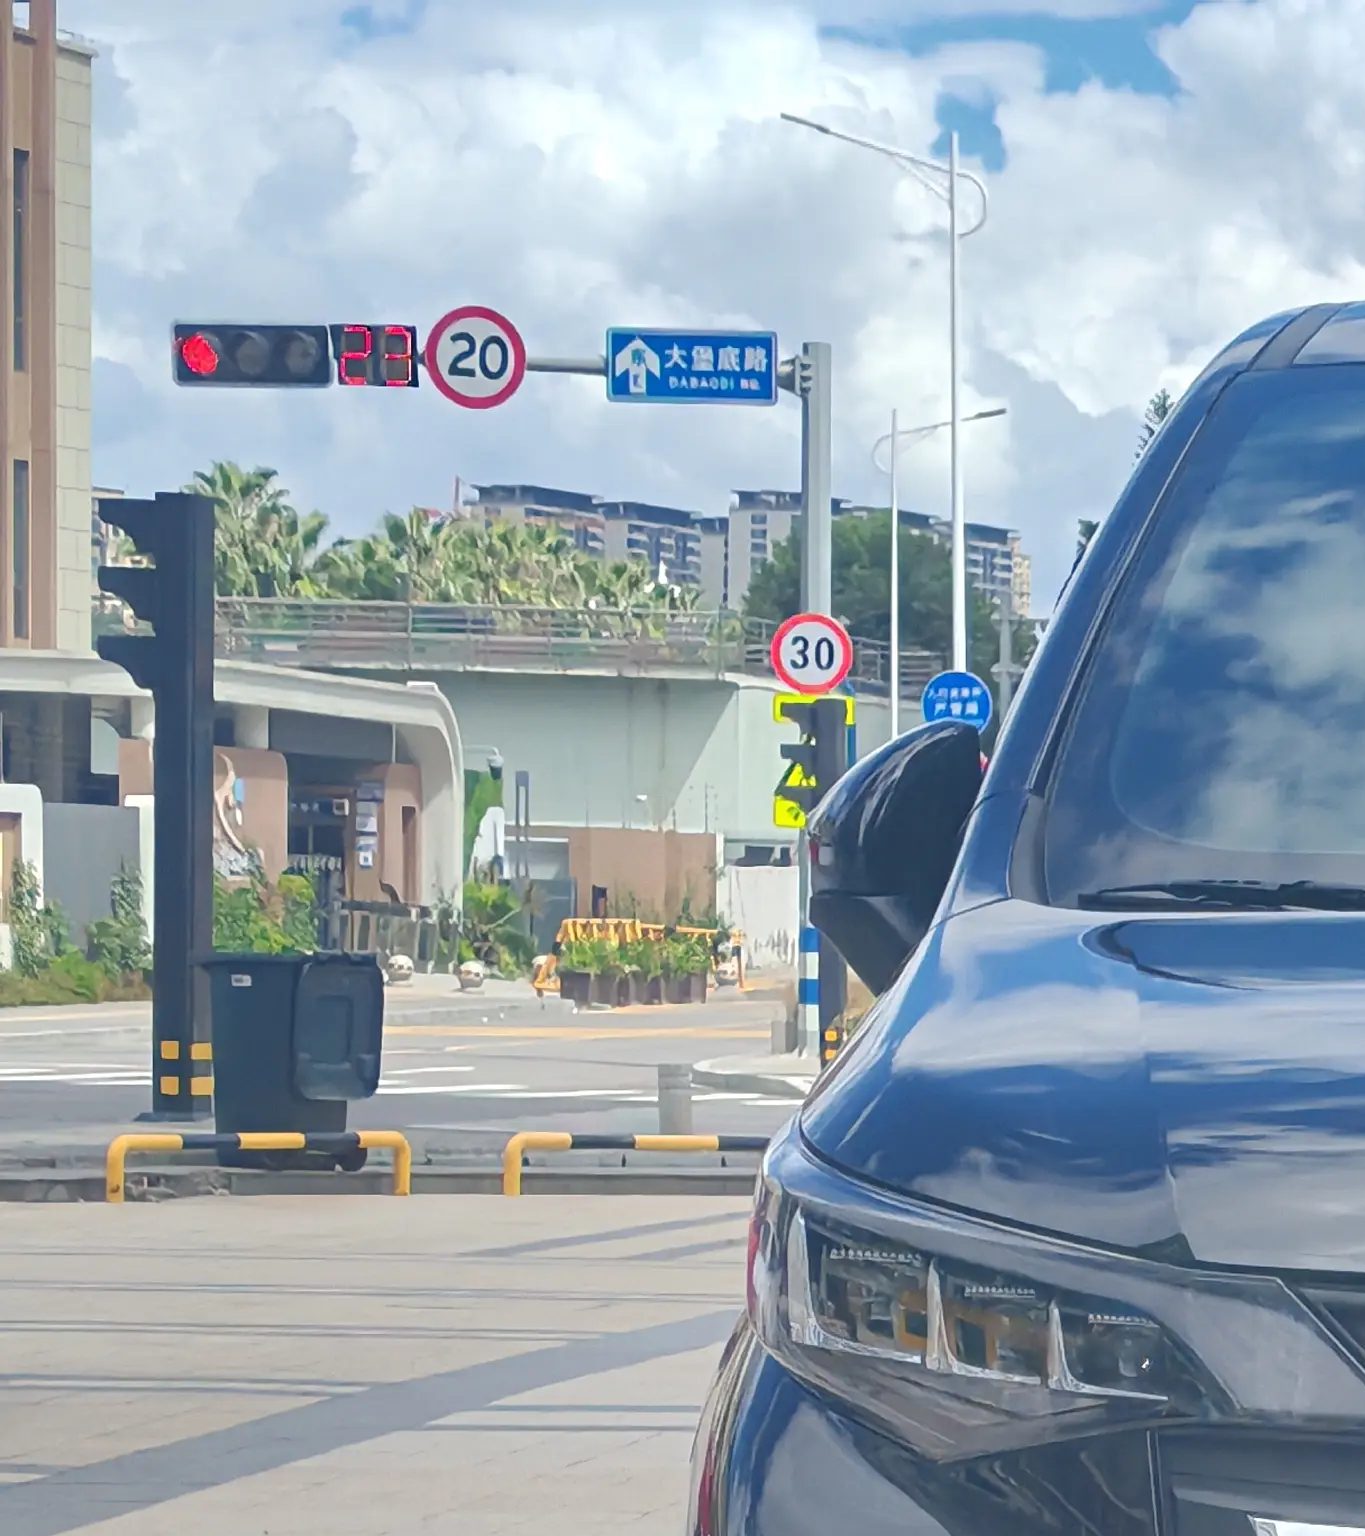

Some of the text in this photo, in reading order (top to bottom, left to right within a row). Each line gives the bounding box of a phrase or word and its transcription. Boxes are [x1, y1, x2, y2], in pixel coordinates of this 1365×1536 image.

[340, 325, 412, 386] 23
[448, 332, 509, 380] 20
[790, 636, 835, 671] 30
